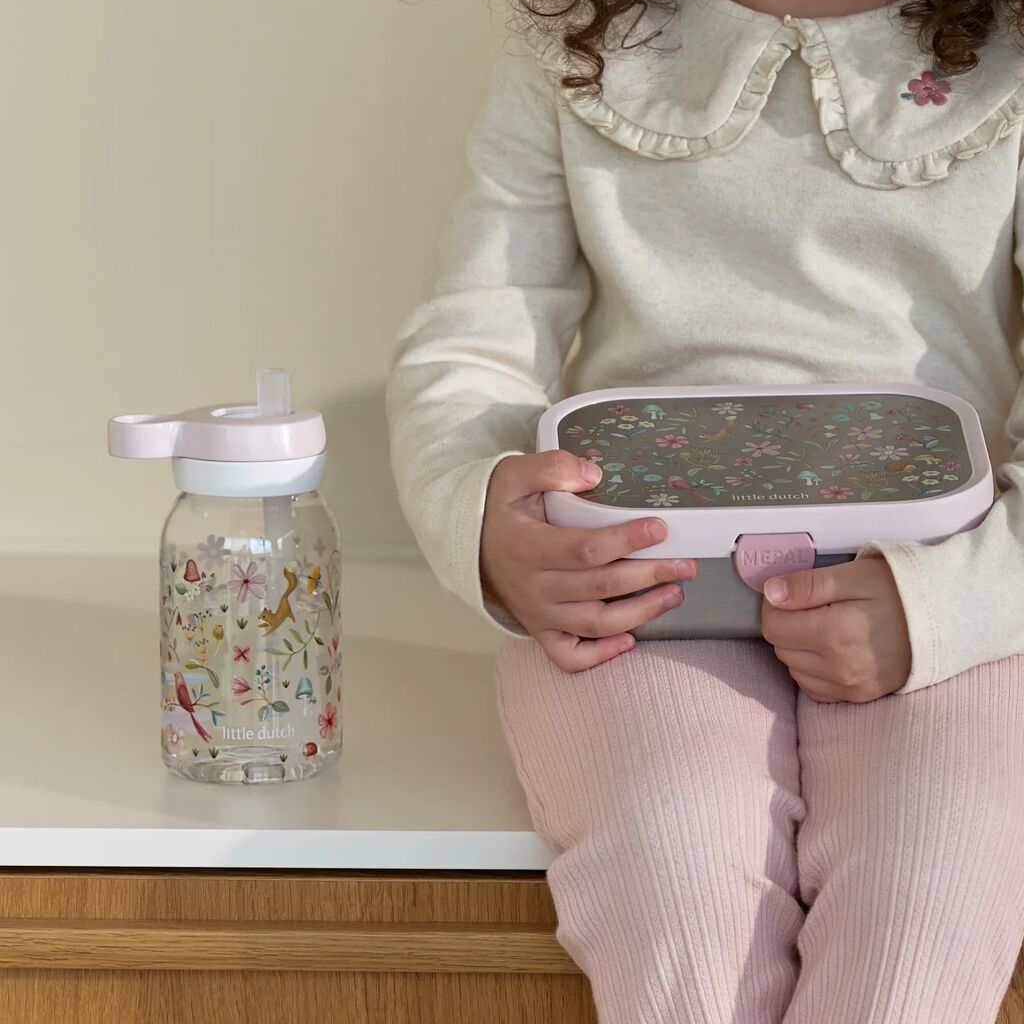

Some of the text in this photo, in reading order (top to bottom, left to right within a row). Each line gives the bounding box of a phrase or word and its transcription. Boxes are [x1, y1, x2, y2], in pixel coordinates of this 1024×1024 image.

[741, 549, 809, 568] MEPAL
[222, 724, 296, 740] little dutch
